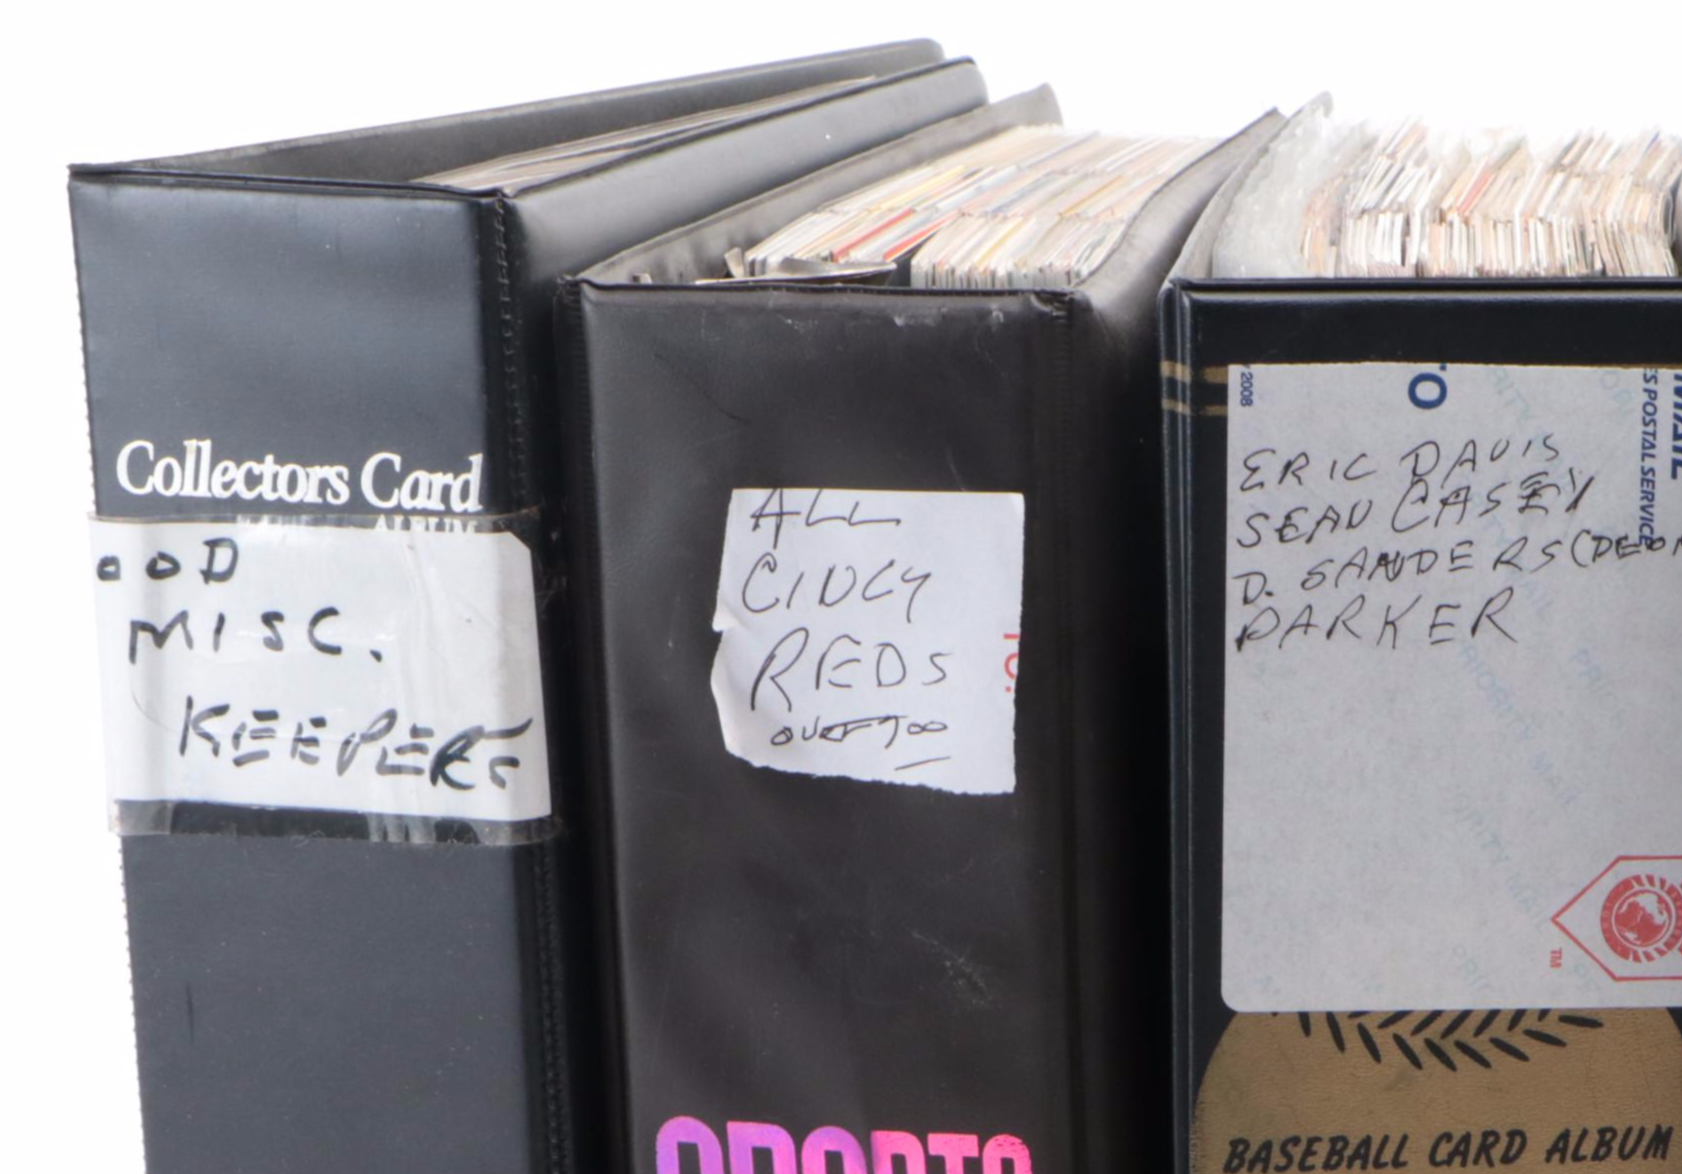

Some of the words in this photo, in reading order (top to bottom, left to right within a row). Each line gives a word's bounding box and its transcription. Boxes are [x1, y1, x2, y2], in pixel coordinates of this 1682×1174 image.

[1240, 370, 1254, 408] 2008
[1641, 387, 1658, 463] POSTAL
[115, 439, 350, 505] Collectors
[360, 451, 484, 513] Card
[1239, 448, 1379, 492] ERIC
[1399, 434, 1560, 484] DAVIS
[750, 488, 902, 550] ALL
[1391, 465, 1596, 534] CASEY
[1638, 464, 1656, 548] SERVICE
[1231, 570, 1276, 606] D.
[1234, 585, 1519, 653] PARKER
[128, 606, 383, 665] MISC.
[1222, 1133, 1410, 1174] BASEBALL
[1428, 1129, 1528, 1168] CARD
[1545, 1124, 1675, 1164] ALBUM
